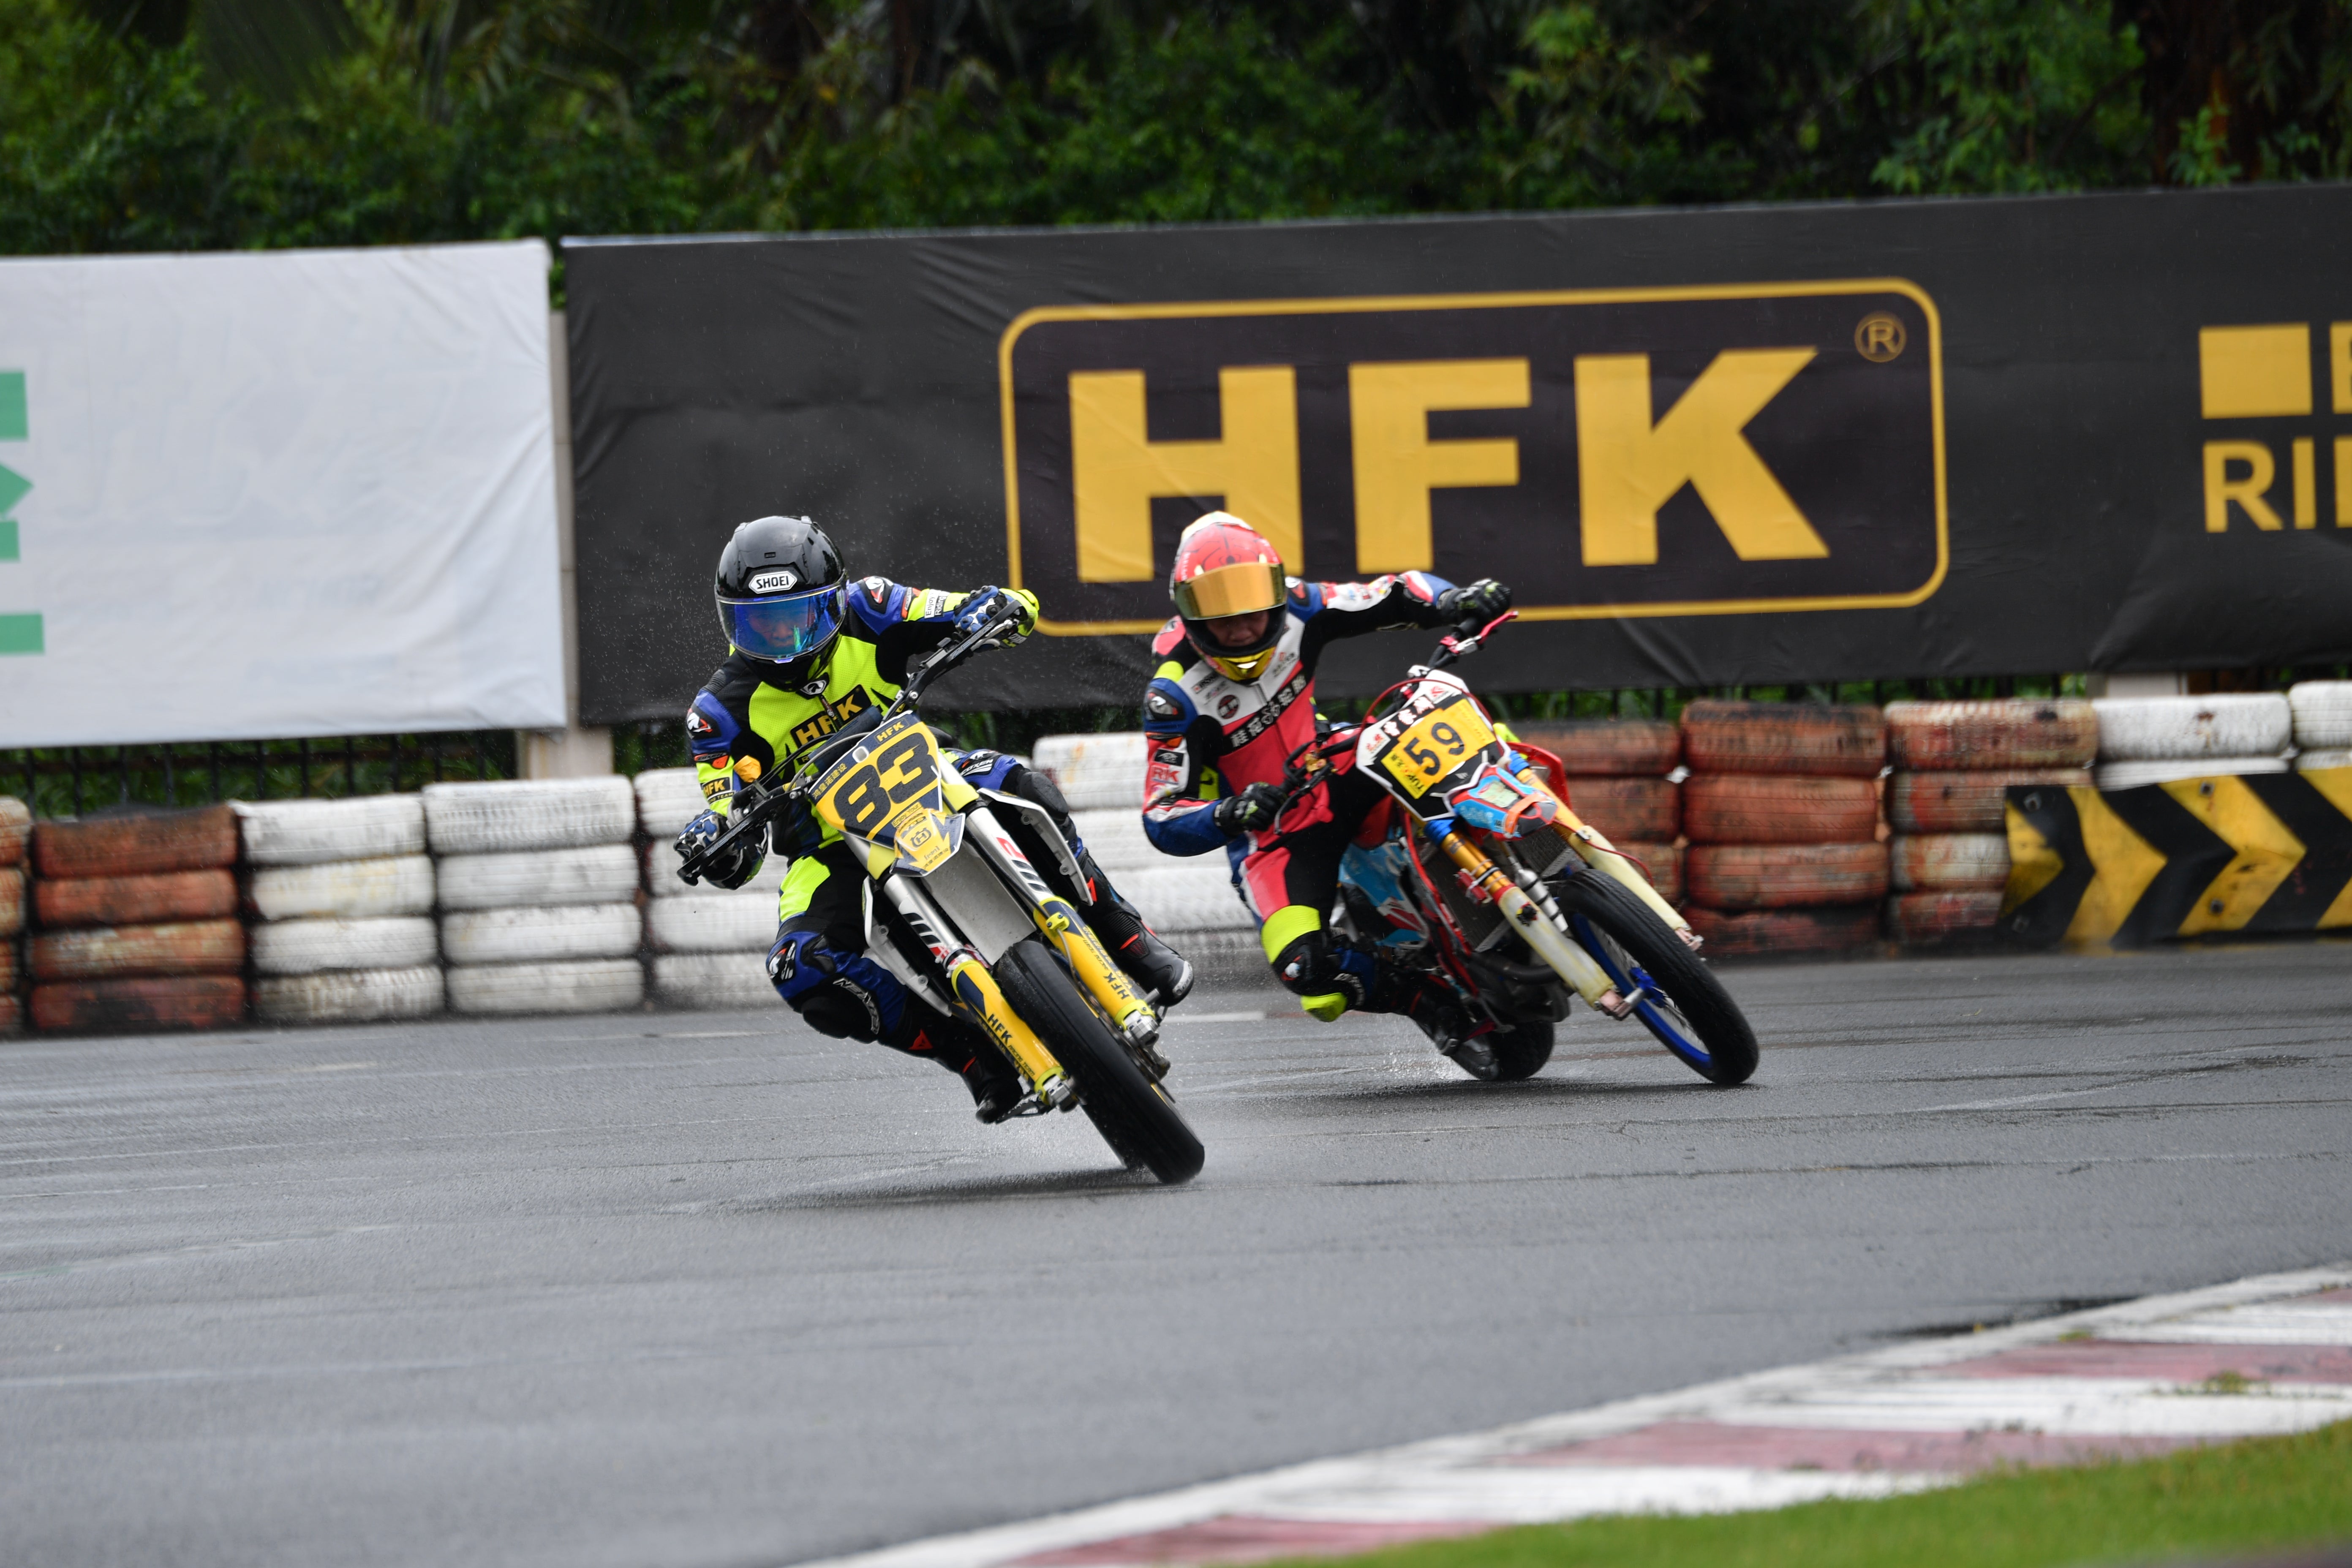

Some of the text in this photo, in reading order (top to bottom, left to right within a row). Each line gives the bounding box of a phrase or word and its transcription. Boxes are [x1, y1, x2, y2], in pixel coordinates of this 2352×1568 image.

[1068, 346, 1831, 583] HFK
[2203, 435, 2352, 533] RI
[756, 576, 789, 589] SHOEI
[925, 593, 936, 617] Enjoy
[935, 596, 947, 615] Riding
[950, 625, 992, 659] ZETA
[876, 721, 905, 742] HFK
[1403, 722, 1465, 776] 59
[960, 759, 994, 776] COXEN
[703, 779, 726, 798] HFK
[833, 732, 938, 838] 83
[893, 804, 919, 826] Enjoy Your
[706, 822, 749, 855] ZETA
[1102, 972, 1130, 1000] HFK
[987, 1013, 1013, 1045] HFK
